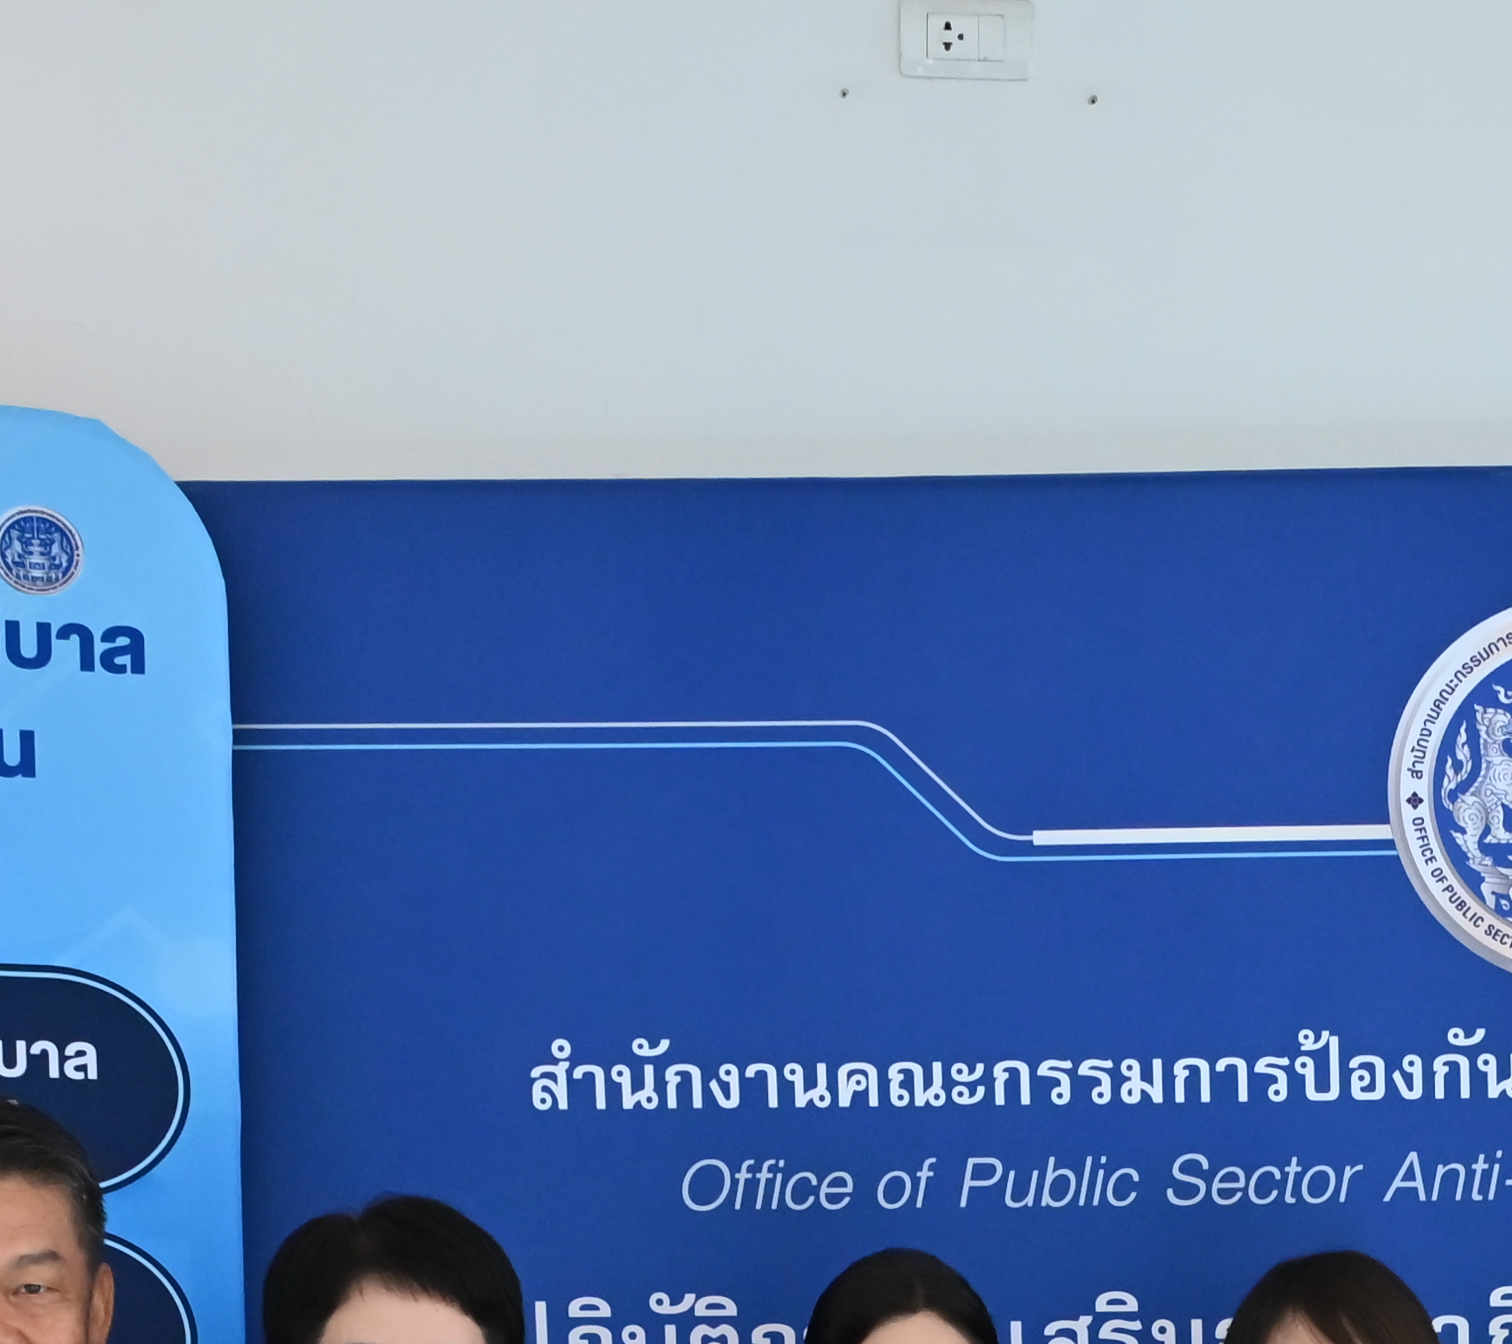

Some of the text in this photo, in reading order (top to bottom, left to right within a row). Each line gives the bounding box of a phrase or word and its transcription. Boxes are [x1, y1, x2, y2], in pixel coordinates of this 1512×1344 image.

[1411, 816, 1441, 867] OFFICE
[1430, 865, 1448, 888] OF
[1442, 882, 1485, 929] PUBLIC
[681, 1158, 854, 1212] Office
[876, 1157, 937, 1210] of
[958, 1155, 1140, 1209] Public
[1166, 1153, 1364, 1207] Sector
